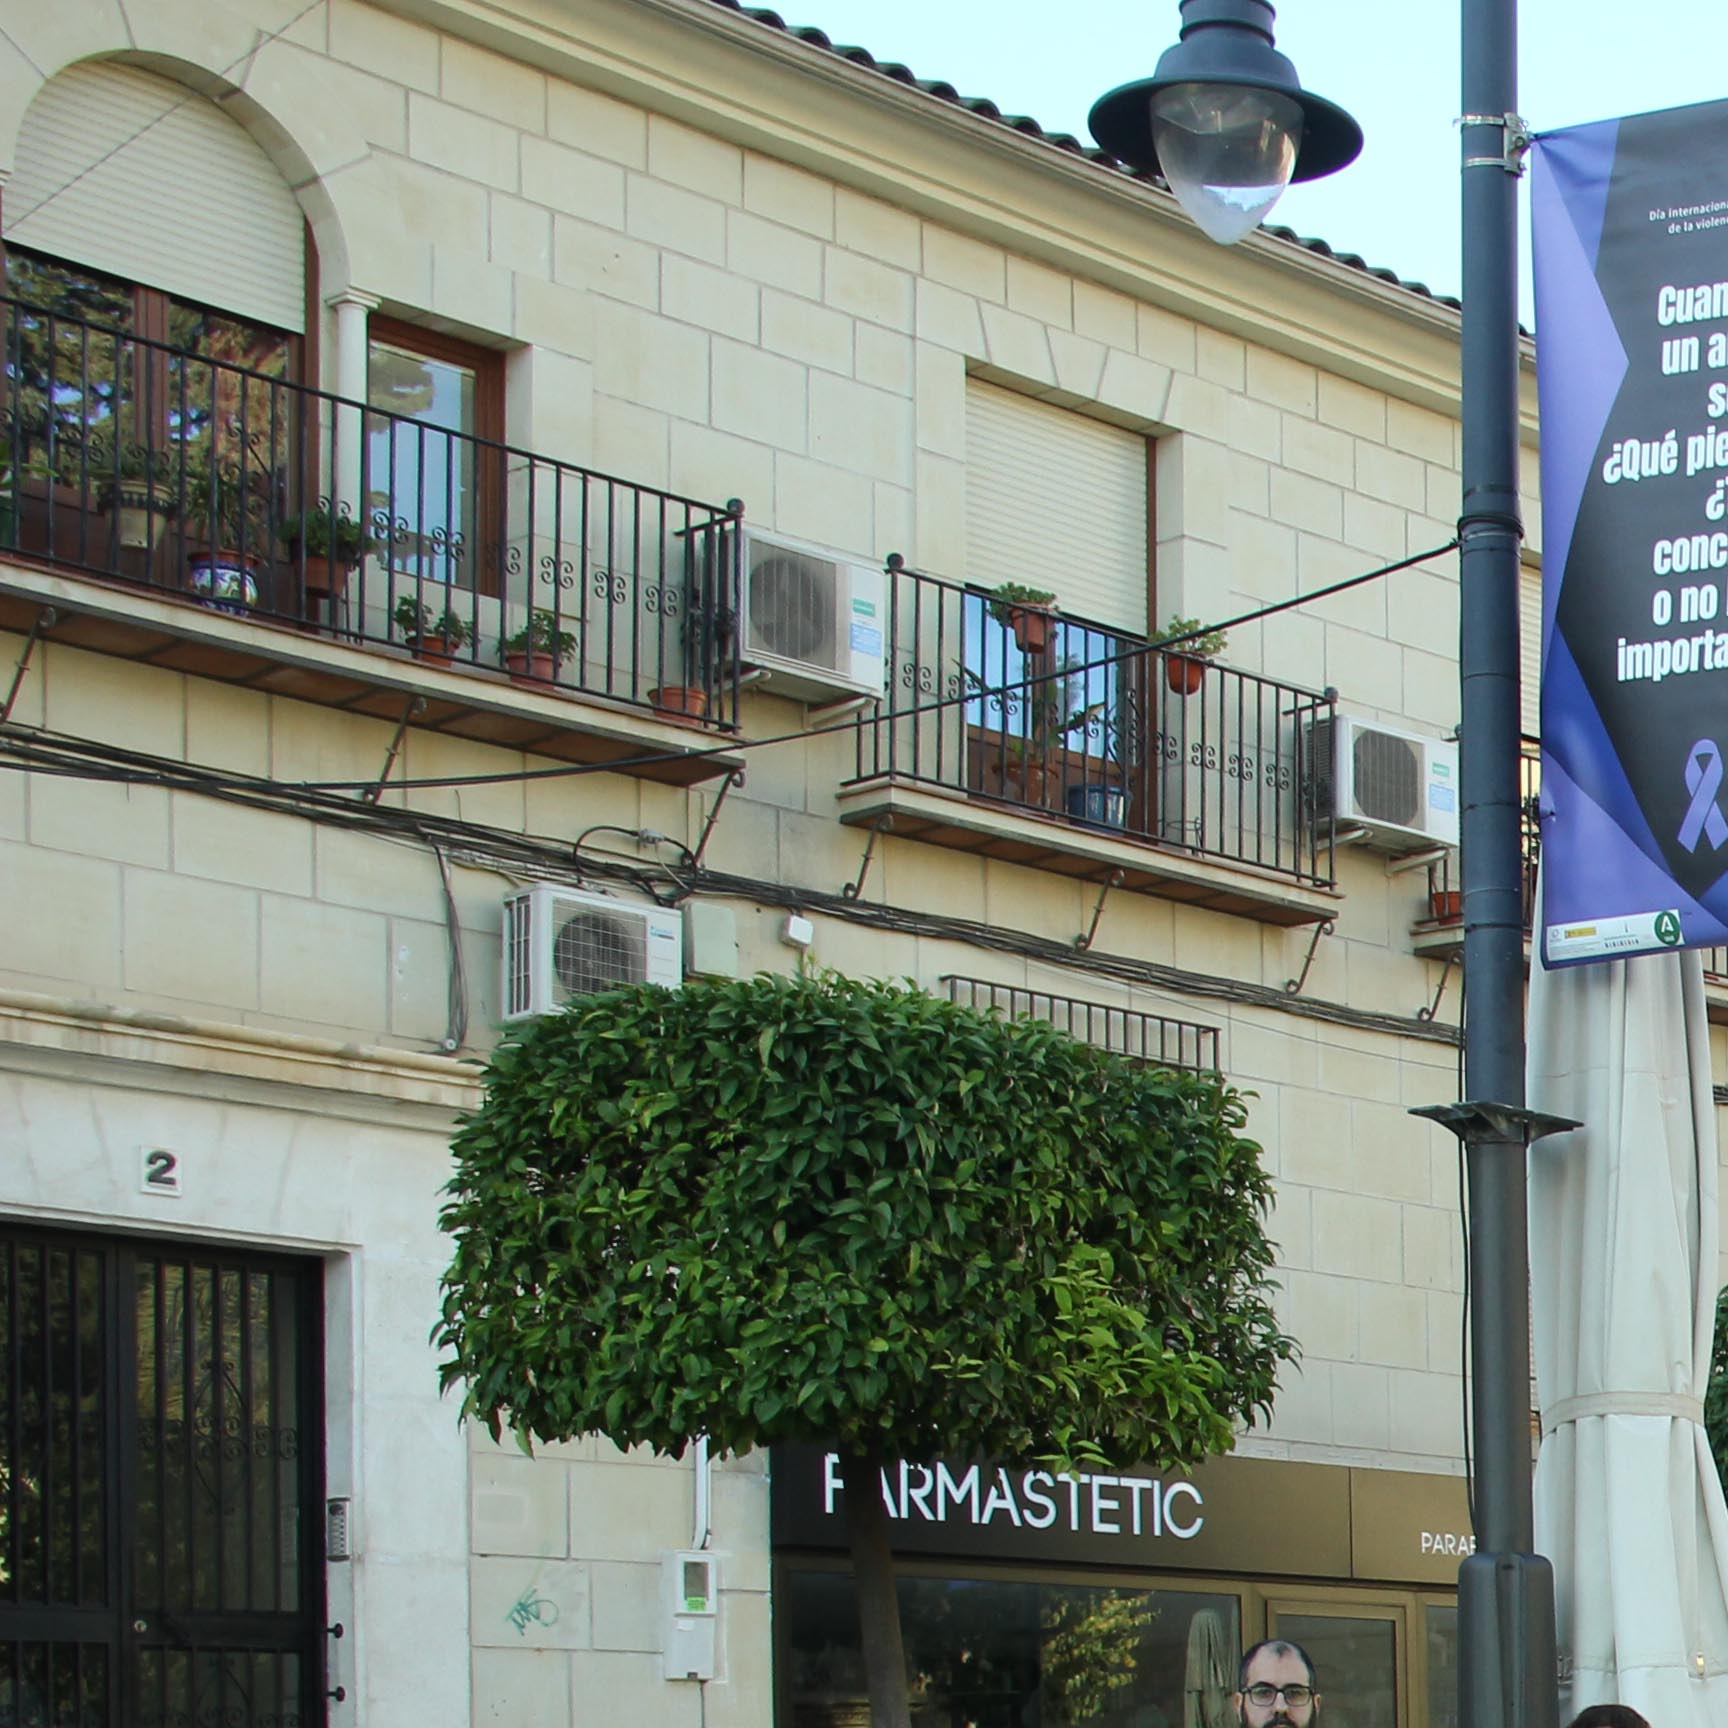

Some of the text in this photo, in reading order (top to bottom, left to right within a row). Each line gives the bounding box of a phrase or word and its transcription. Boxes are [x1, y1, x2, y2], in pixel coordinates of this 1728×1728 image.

[1649, 210, 1665, 222] Día
[1668, 223, 1681, 234] de
[1684, 222, 1694, 232] la
[1661, 336, 1699, 376] un
[1602, 429, 1679, 485] ¿Qué
[1653, 590, 1673, 626] o
[1680, 584, 1718, 624] no
[145, 1150, 178, 1186] 2
